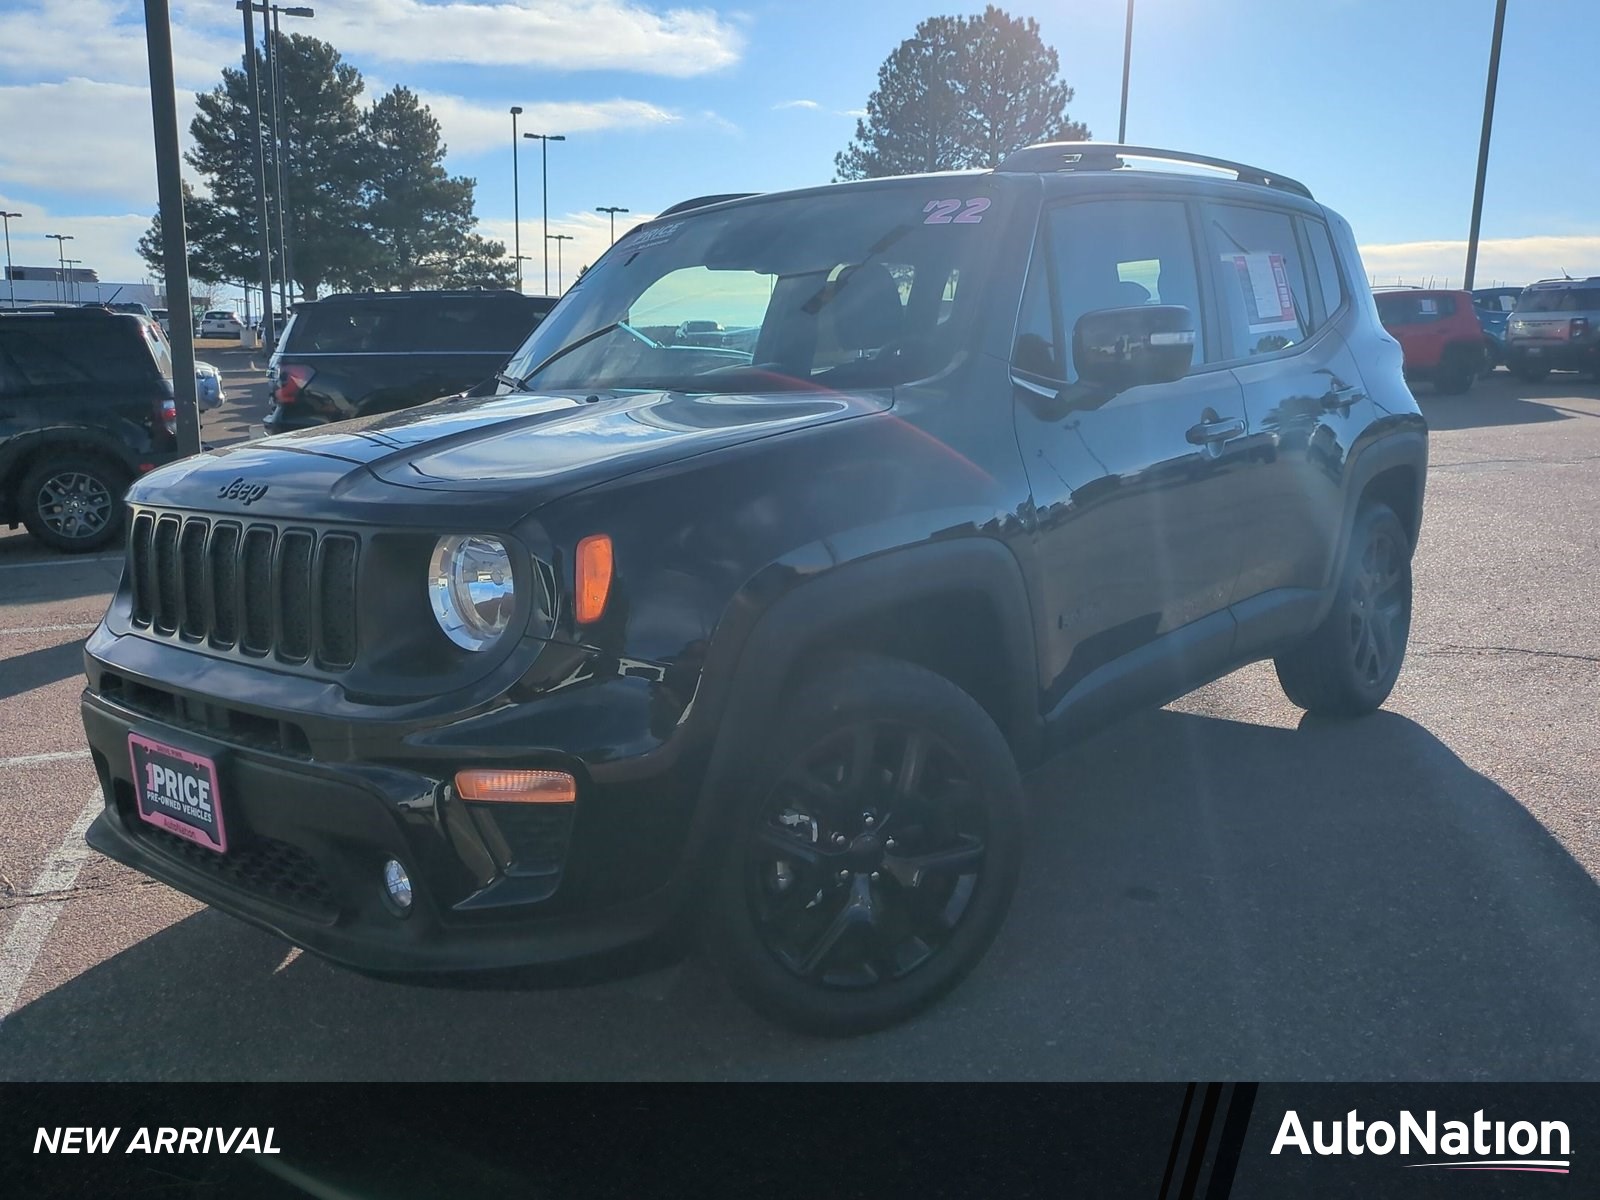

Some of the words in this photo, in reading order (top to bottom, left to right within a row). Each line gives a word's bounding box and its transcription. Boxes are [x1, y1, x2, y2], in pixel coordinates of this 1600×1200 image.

[922, 197, 991, 224] '22
[217, 477, 269, 506] Jeep
[146, 791, 181, 811] PRE-OWNED
[182, 803, 212, 823] VEHICLES
